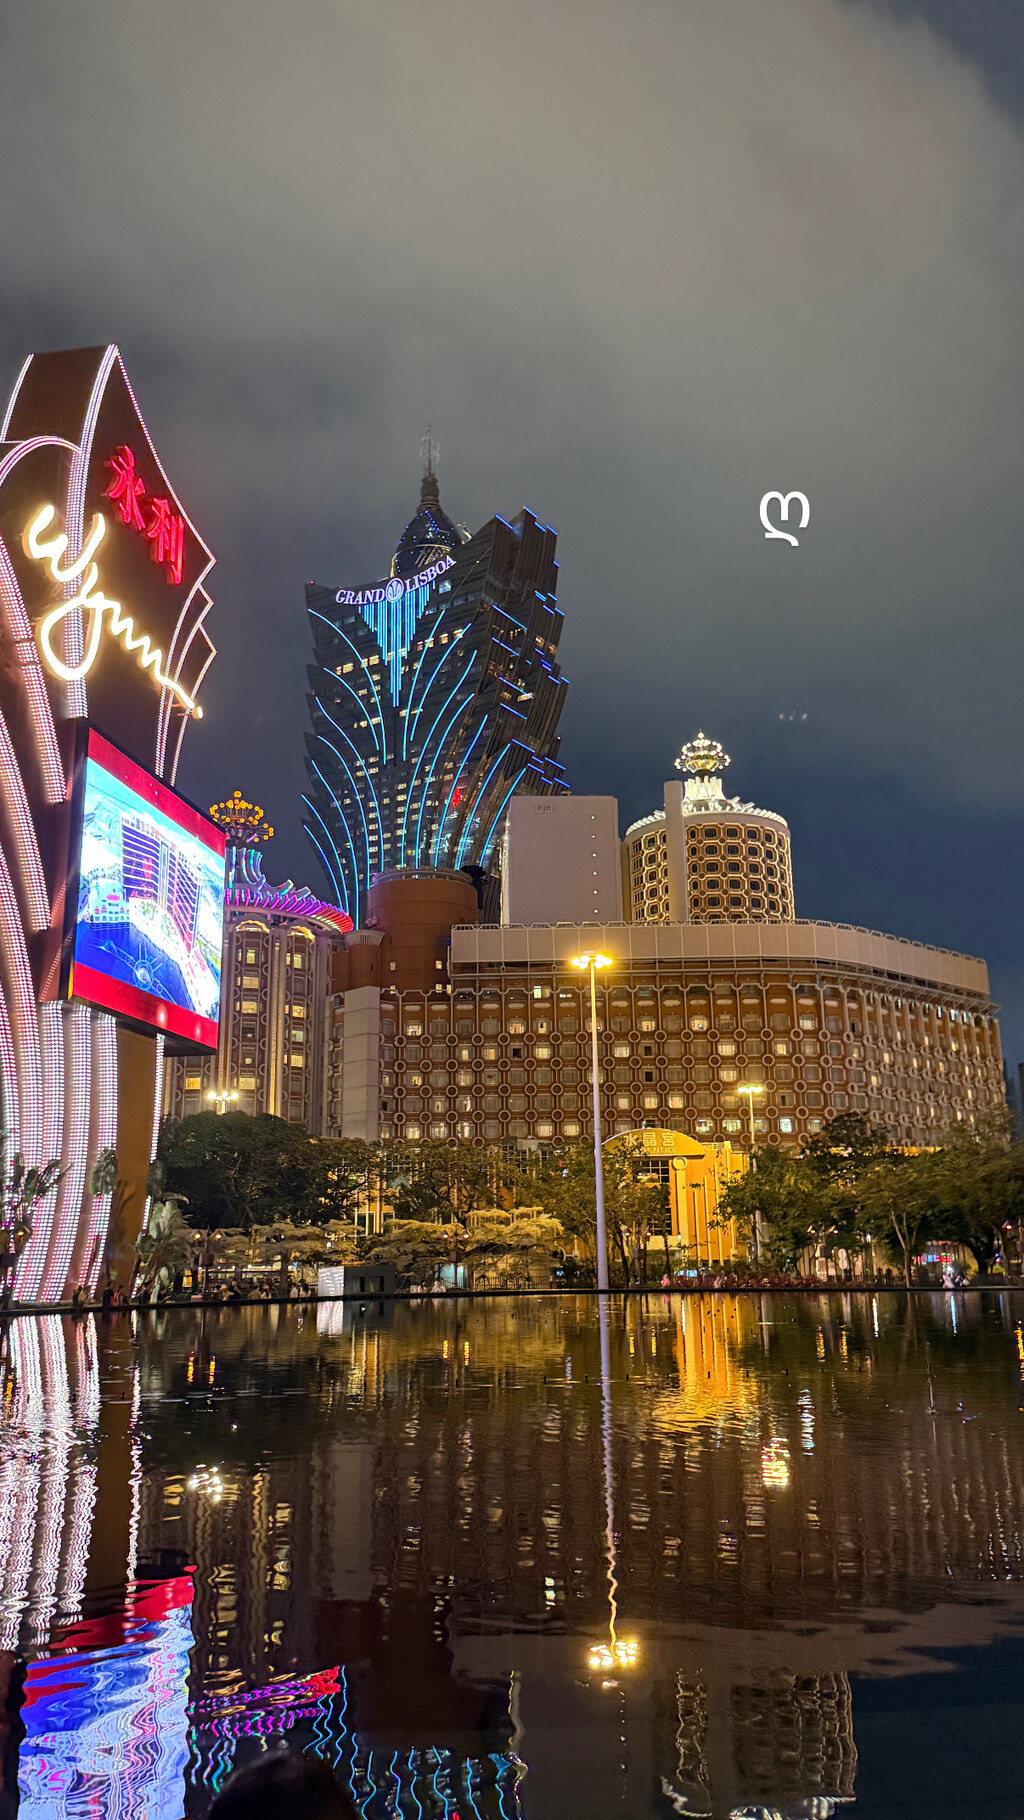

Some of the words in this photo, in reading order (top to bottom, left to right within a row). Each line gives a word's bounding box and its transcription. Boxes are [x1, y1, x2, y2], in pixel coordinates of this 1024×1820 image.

[103, 444, 185, 585] 永利
[335, 588, 386, 605] GRAND
[404, 555, 457, 594] LISBOA
[623, 1132, 676, 1147] 水晶宮
